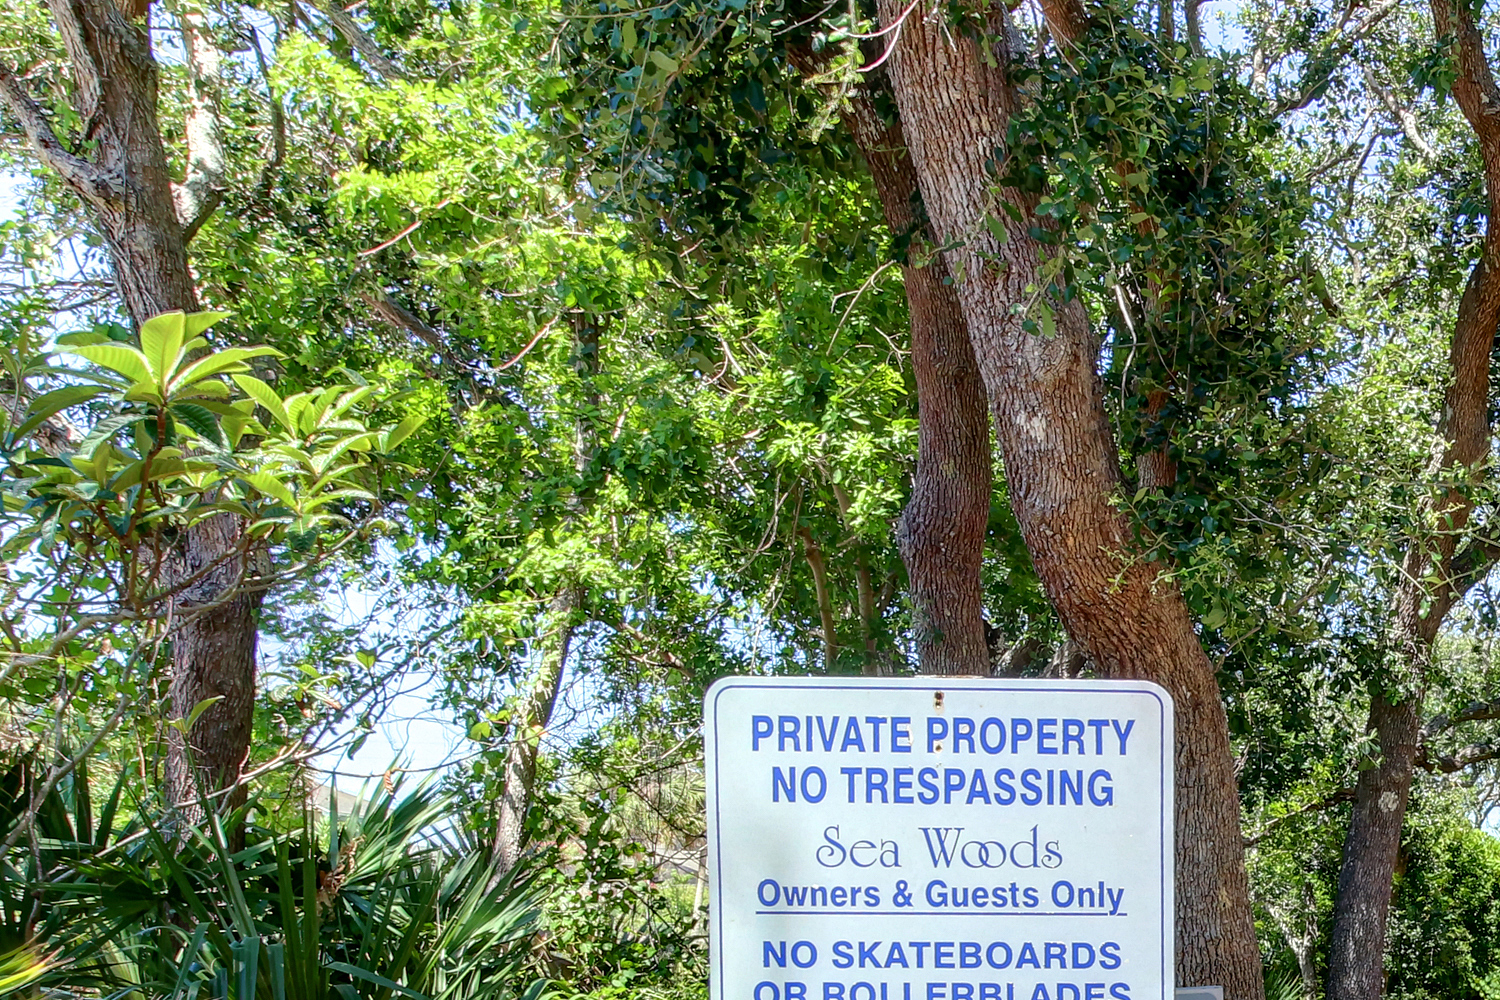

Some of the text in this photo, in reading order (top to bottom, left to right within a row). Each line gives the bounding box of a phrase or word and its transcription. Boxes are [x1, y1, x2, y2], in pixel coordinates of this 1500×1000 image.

[751, 715, 1135, 756] PRIVATE PROPERTY
[771, 766, 1114, 807] NO TRESPASSING
[815, 823, 1063, 869] Sea Woods
[757, 879, 1125, 916] Owners & Guests Only
[762, 940, 1122, 970] NO SKATEBOARDS
